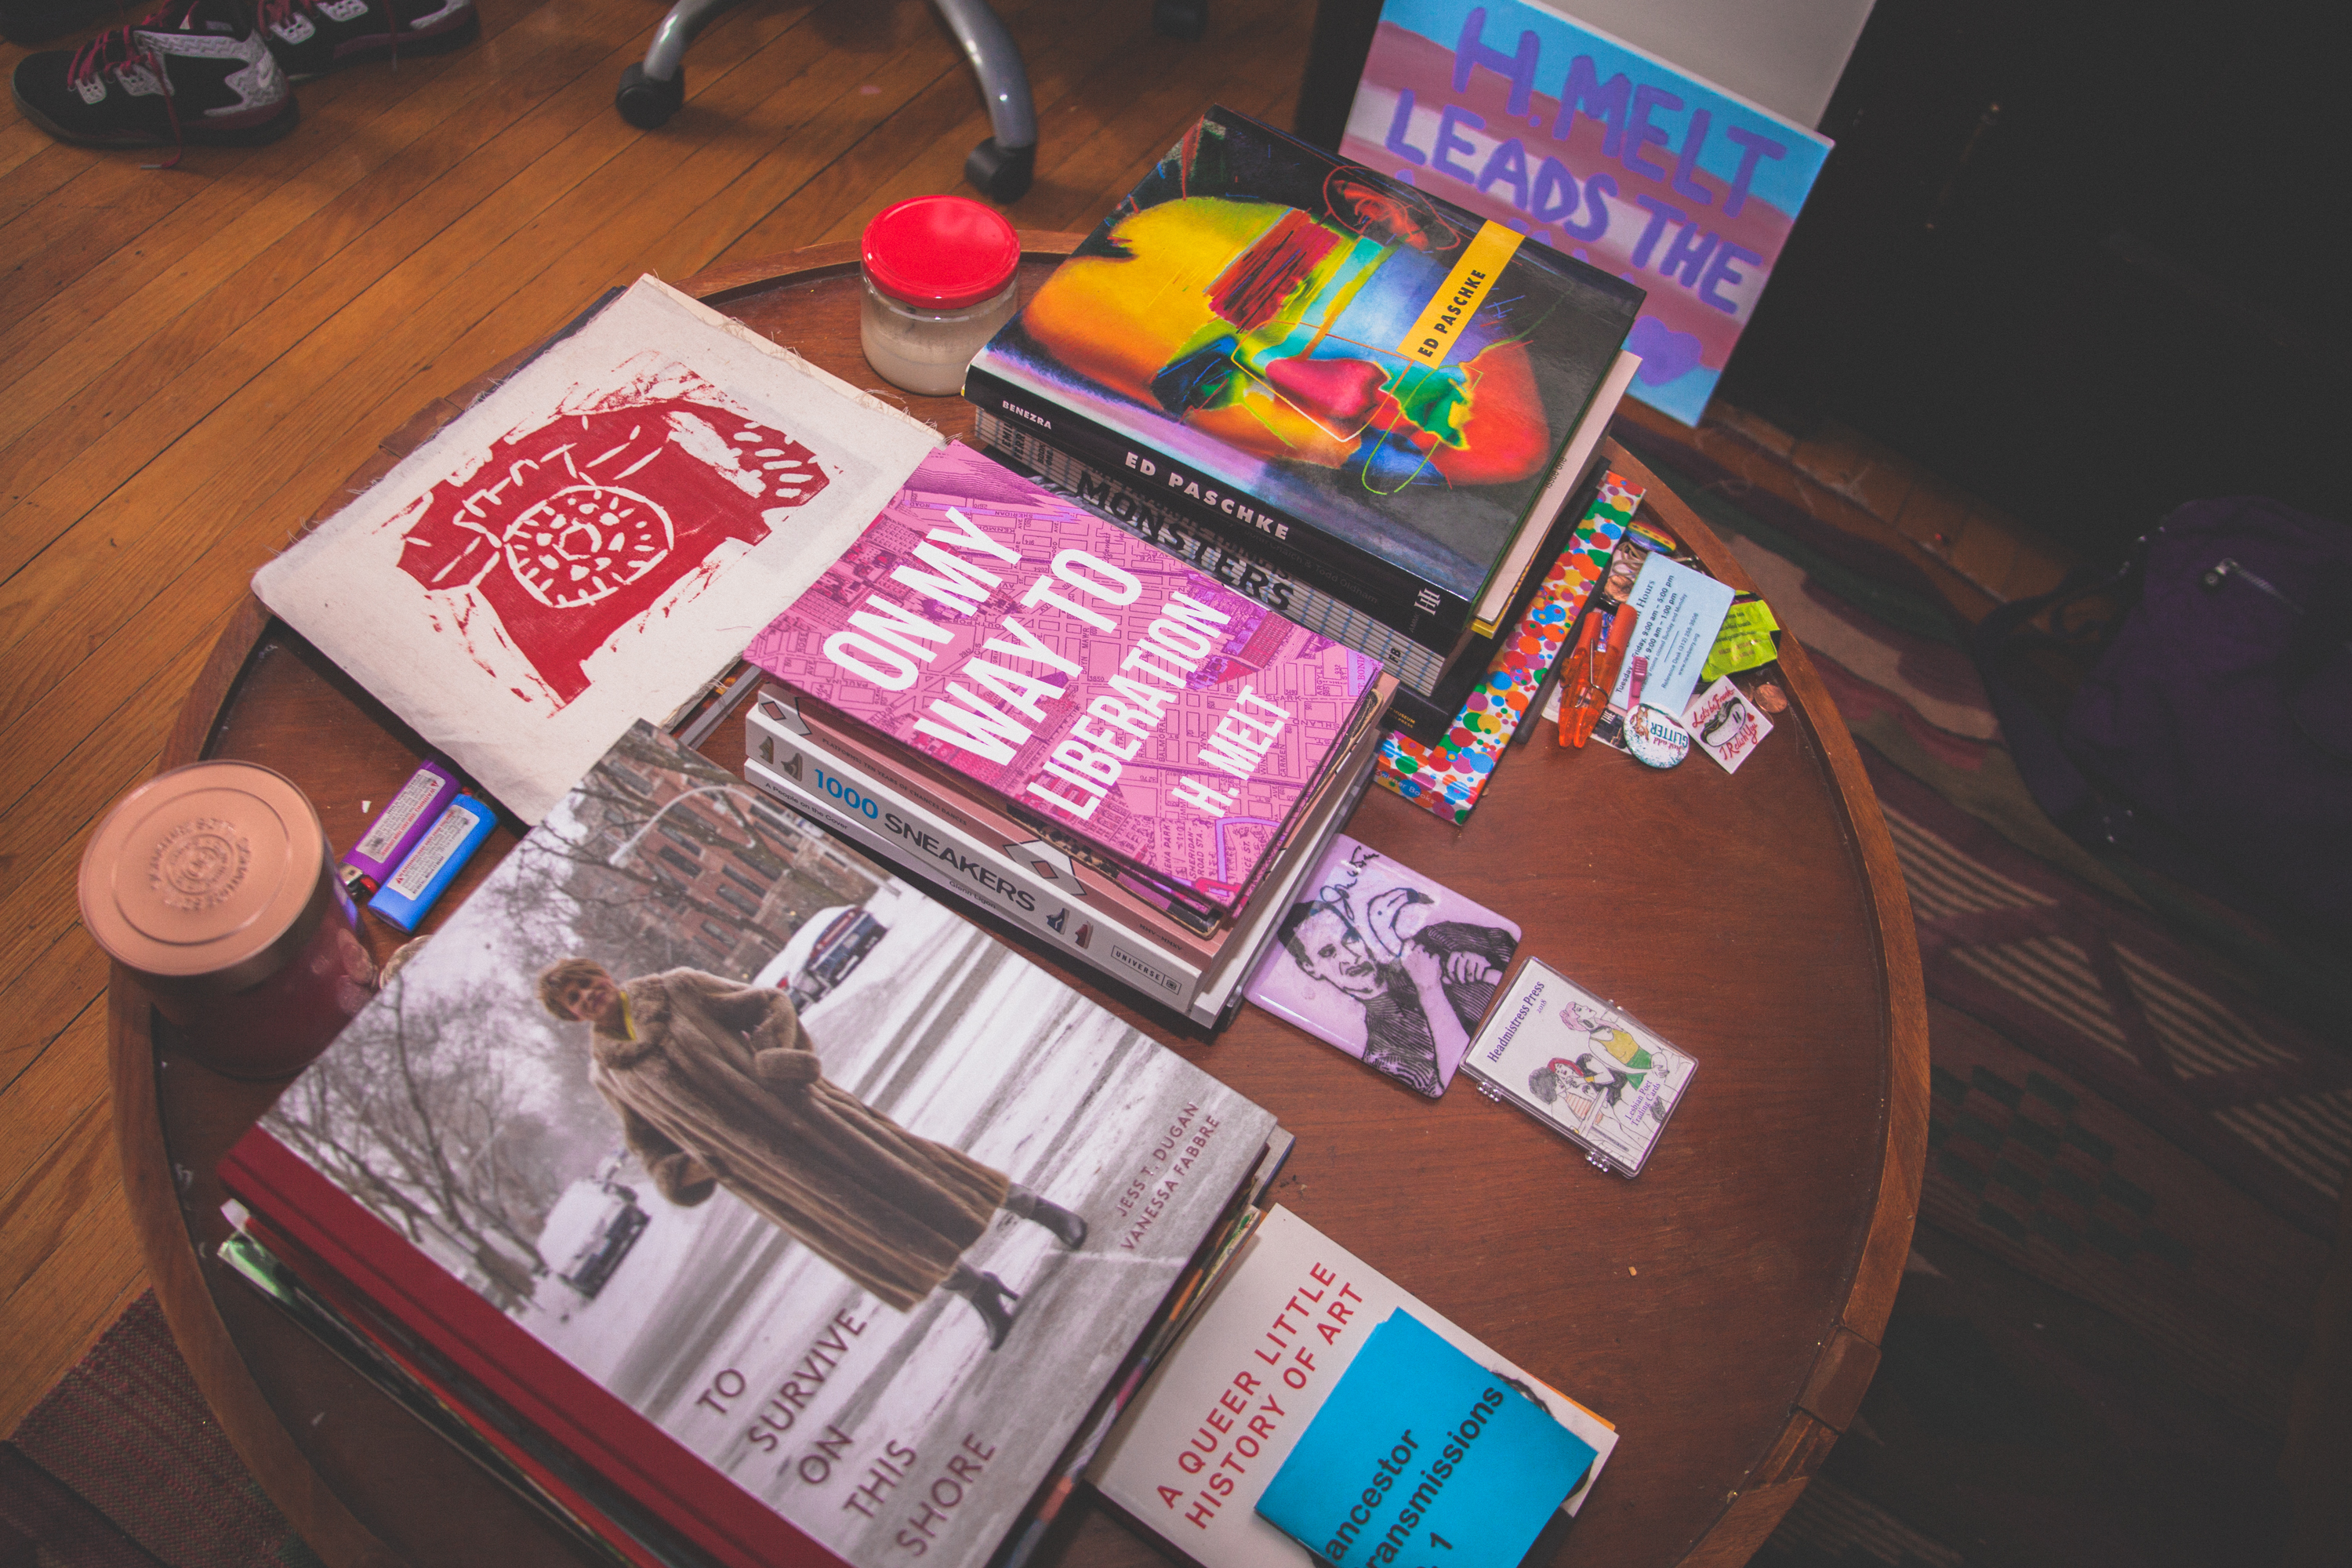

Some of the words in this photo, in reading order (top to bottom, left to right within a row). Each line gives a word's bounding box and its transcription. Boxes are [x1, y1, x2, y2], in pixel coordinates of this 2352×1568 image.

[1452, 6, 1541, 127] H.
[1552, 55, 1787, 219] MELT
[1385, 88, 1618, 242] LEADS
[1635, 194, 1763, 314] THE
[1417, 339, 1441, 358] ED
[1433, 268, 1486, 336] PASCHKE
[1003, 401, 1051, 430] BENEZRA
[1125, 452, 1156, 476] ED
[1168, 472, 1289, 539] PASCHKE
[1076, 470, 1294, 611] MONSTERS
[823, 593, 955, 691] ON
[890, 506, 1022, 617] MY
[1314, 565, 1338, 582] Todd
[1338, 578, 1379, 604] Oldham
[1636, 579, 1655, 608] Hours
[1646, 638, 1657, 653] 9:00
[1653, 626, 1662, 637] am
[1661, 604, 1671, 619] 1:00
[1668, 593, 1677, 604] pm
[913, 615, 1083, 767] WAY
[1020, 549, 1142, 633] TO
[1388, 648, 1401, 663] FB
[1615, 666, 1633, 694] Tuesday
[1642, 621, 1653, 637] 9:00
[1650, 610, 1658, 621] am
[1657, 588, 1668, 603] 5:00
[1665, 575, 1675, 587] pm
[1648, 657, 1658, 670] rooms
[1655, 640, 1665, 655] closed
[1662, 622, 1674, 640] Sunday
[1673, 593, 1688, 612] Monday
[1660, 664, 1676, 688] Reference
[1671, 651, 1681, 664] Desk
[1676, 633, 1701, 676] www.newberry.org
[1025, 590, 1232, 821] LIBERATION
[1197, 684, 1291, 780] MELT
[1650, 722, 1687, 748] GLITTER
[1707, 701, 1717, 712] be
[773, 786, 798, 805] People
[811, 806, 824, 816] the
[826, 815, 848, 829] Cover
[863, 761, 877, 771] TEN
[878, 768, 898, 785] YEARS
[899, 782, 908, 791] OF
[910, 789, 940, 810] CHANCES
[942, 808, 967, 826] DANCES
[1171, 776, 1240, 818] H.
[814, 768, 879, 819] 1000
[884, 812, 1035, 912] SNEAKERS
[1163, 819, 1172, 848] PARK
[1196, 849, 1205, 877] ROAD
[949, 880, 972, 896] Glenn
[972, 894, 996, 909] Ligon
[1116, 951, 1161, 981] UNIVERSE
[1487, 1001, 1529, 1063] Headmistress
[1524, 980, 1545, 1006] Press
[1536, 999, 1548, 1014] 2018
[1624, 1095, 1644, 1120] Lesbian
[1639, 1080, 1652, 1096] Poet
[1631, 1101, 1651, 1126] Trading
[1646, 1082, 1661, 1102] Cards
[1116, 1185, 1142, 1218] JESS
[1140, 1163, 1161, 1180] T.
[1152, 1101, 1200, 1161] DUGAN
[1120, 1175, 1178, 1251] VANESSA
[1174, 1113, 1220, 1179] FABBRE
[695, 1367, 747, 1416] TO
[747, 1305, 867, 1454] SURVIVE
[1156, 1483, 1184, 1510] A
[1177, 1369, 1261, 1475] QUEER
[1254, 1261, 1338, 1366] LITTLE
[1184, 1394, 1286, 1531] HISTORY
[1282, 1346, 1318, 1391] OF
[1316, 1282, 1363, 1346] ART
[797, 1425, 855, 1486] ON
[842, 1439, 917, 1522] THIS
[1366, 1386, 1504, 1568] ransmissions
[895, 1432, 996, 1558] SHORE
[1325, 1428, 1420, 1561] ancestor
